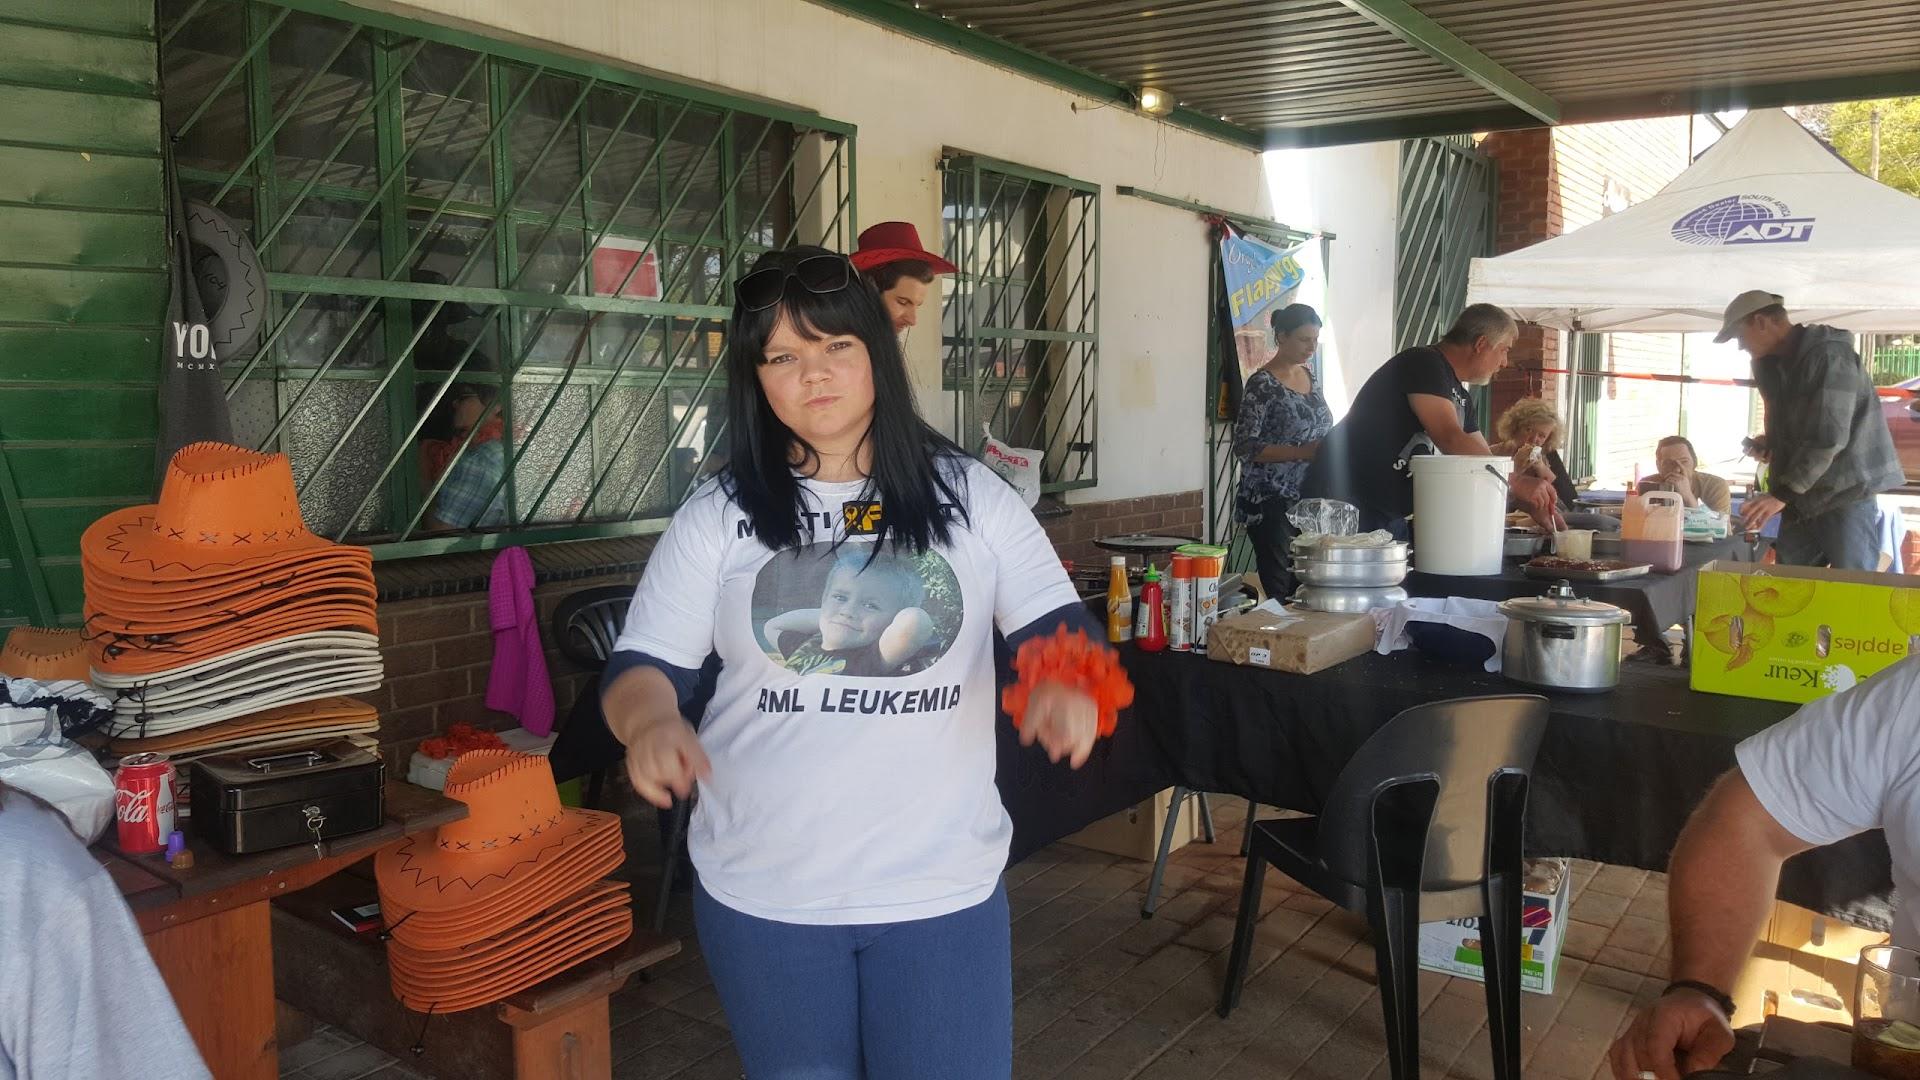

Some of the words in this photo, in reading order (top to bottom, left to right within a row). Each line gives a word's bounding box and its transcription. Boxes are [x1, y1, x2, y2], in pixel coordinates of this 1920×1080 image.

[1725, 222, 1813, 241] ADT
[1834, 637, 1904, 656] apples
[1764, 664, 1819, 688] Keur
[757, 688, 805, 712] AML
[820, 684, 961, 715] LEUKEMIA
